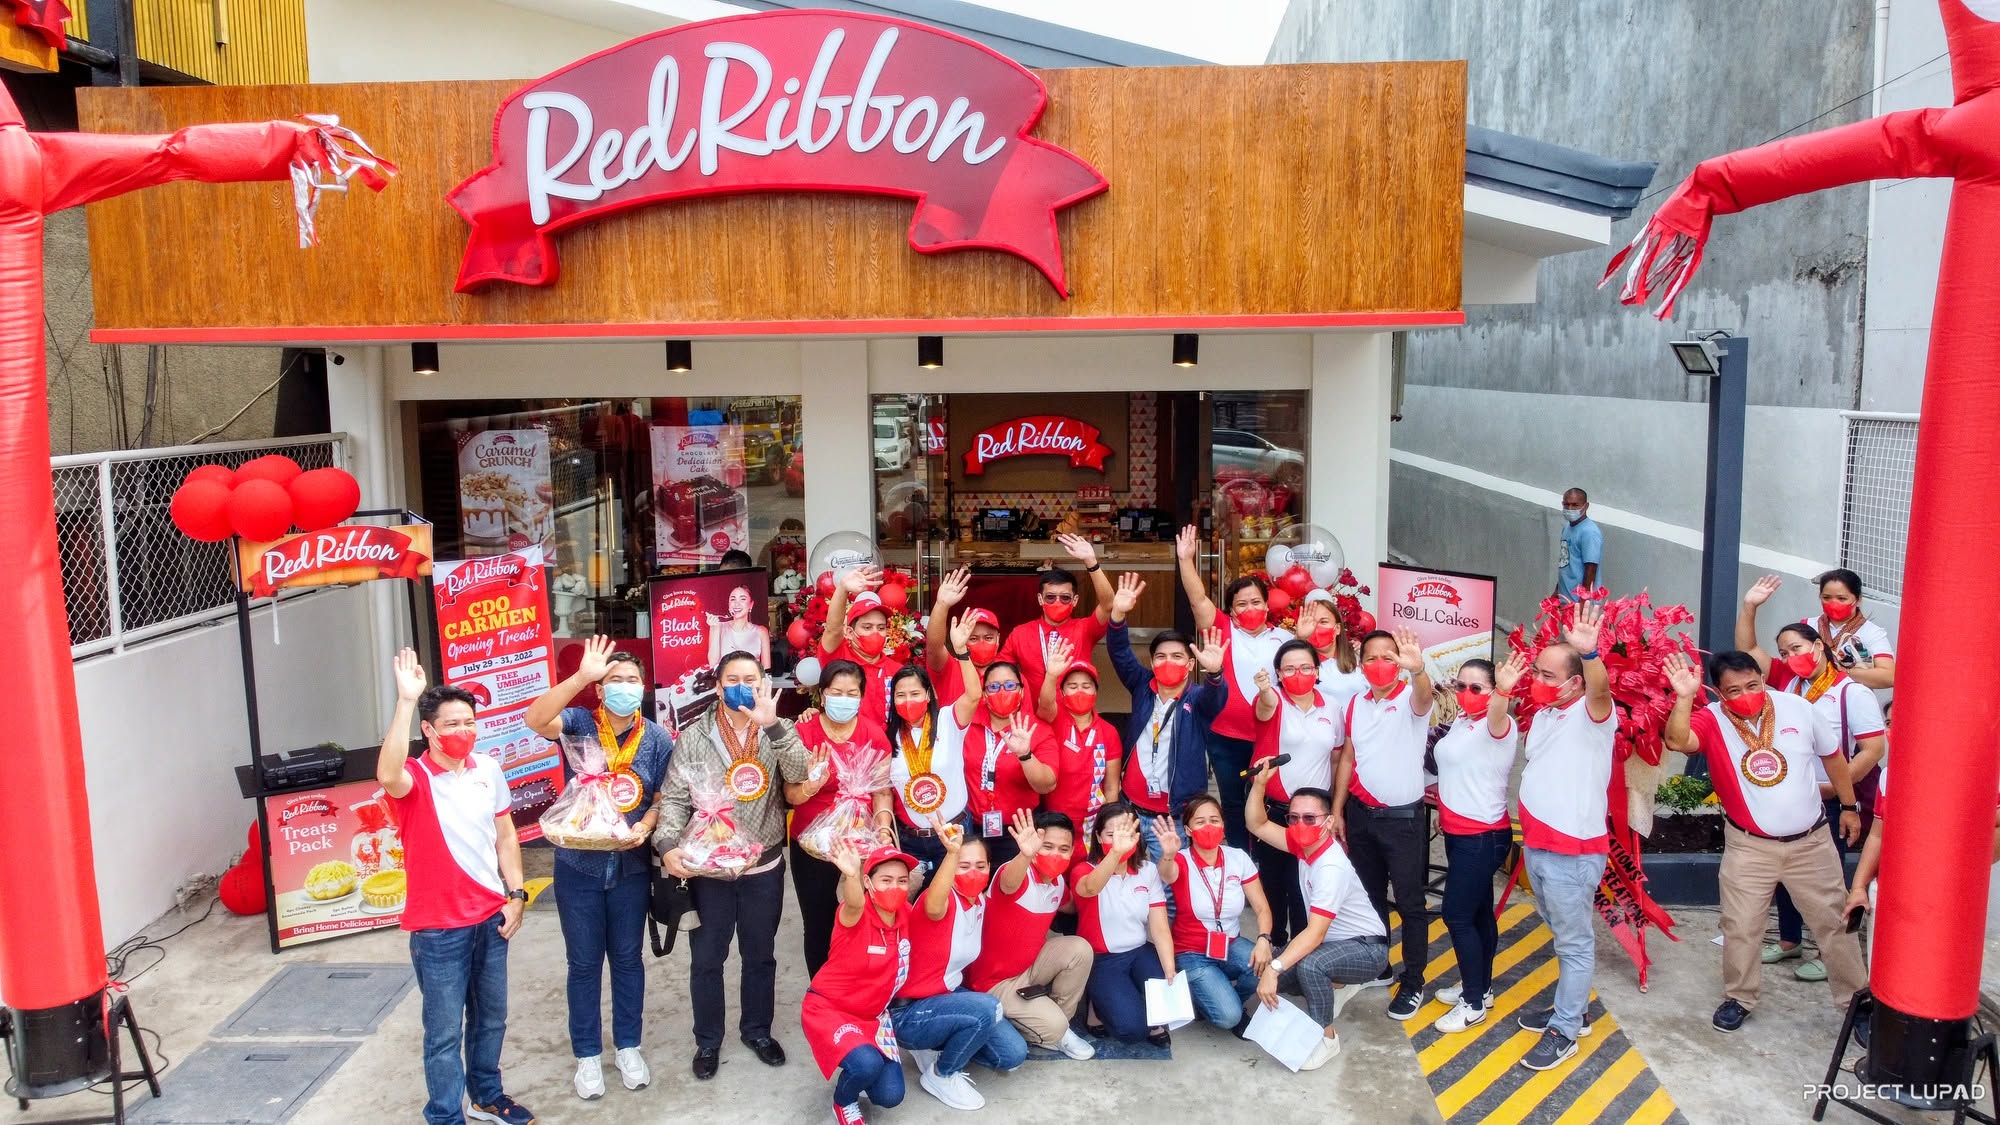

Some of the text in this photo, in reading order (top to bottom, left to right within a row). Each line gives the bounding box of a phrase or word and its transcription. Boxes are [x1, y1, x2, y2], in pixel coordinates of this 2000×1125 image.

[522, 26, 1007, 225] Red Ribbon
[475, 443, 537, 459] Caramel
[978, 426, 1017, 463] Red
[1018, 421, 1087, 453] Ribbon
[479, 456, 532, 469] CRUNCH
[677, 457, 722, 465] Dedication
[690, 465, 710, 473] Cake
[264, 529, 400, 585] Red Ribbon
[448, 557, 521, 597] Red Ribbon
[1412, 584, 1454, 598] Red Ribbon
[468, 595, 510, 618] CDO
[661, 597, 696, 612] Red Ribbon
[444, 606, 537, 640] CARMEN
[660, 616, 701, 633] Black
[1392, 602, 1480, 629] ROLL Cakes
[447, 623, 541, 661] Opening Treats!
[660, 631, 704, 648] Forest
[463, 662, 482, 675] July
[482, 659, 493, 669] 29
[500, 655, 513, 665] 31,
[514, 650, 533, 662] 2022
[495, 670, 519, 682] FREE
[497, 671, 542, 690] UMBRELLA
[484, 719, 508, 729] FREE
[512, 768, 524, 777] FIVE
[524, 760, 551, 773] DESIGNS!
[524, 788, 545, 800] Open!
[283, 800, 329, 821] Red Ribbon
[280, 822, 337, 841] Treats
[289, 835, 333, 855] Pack
[293, 915, 399, 936] Bring Home Delicious Treats!
